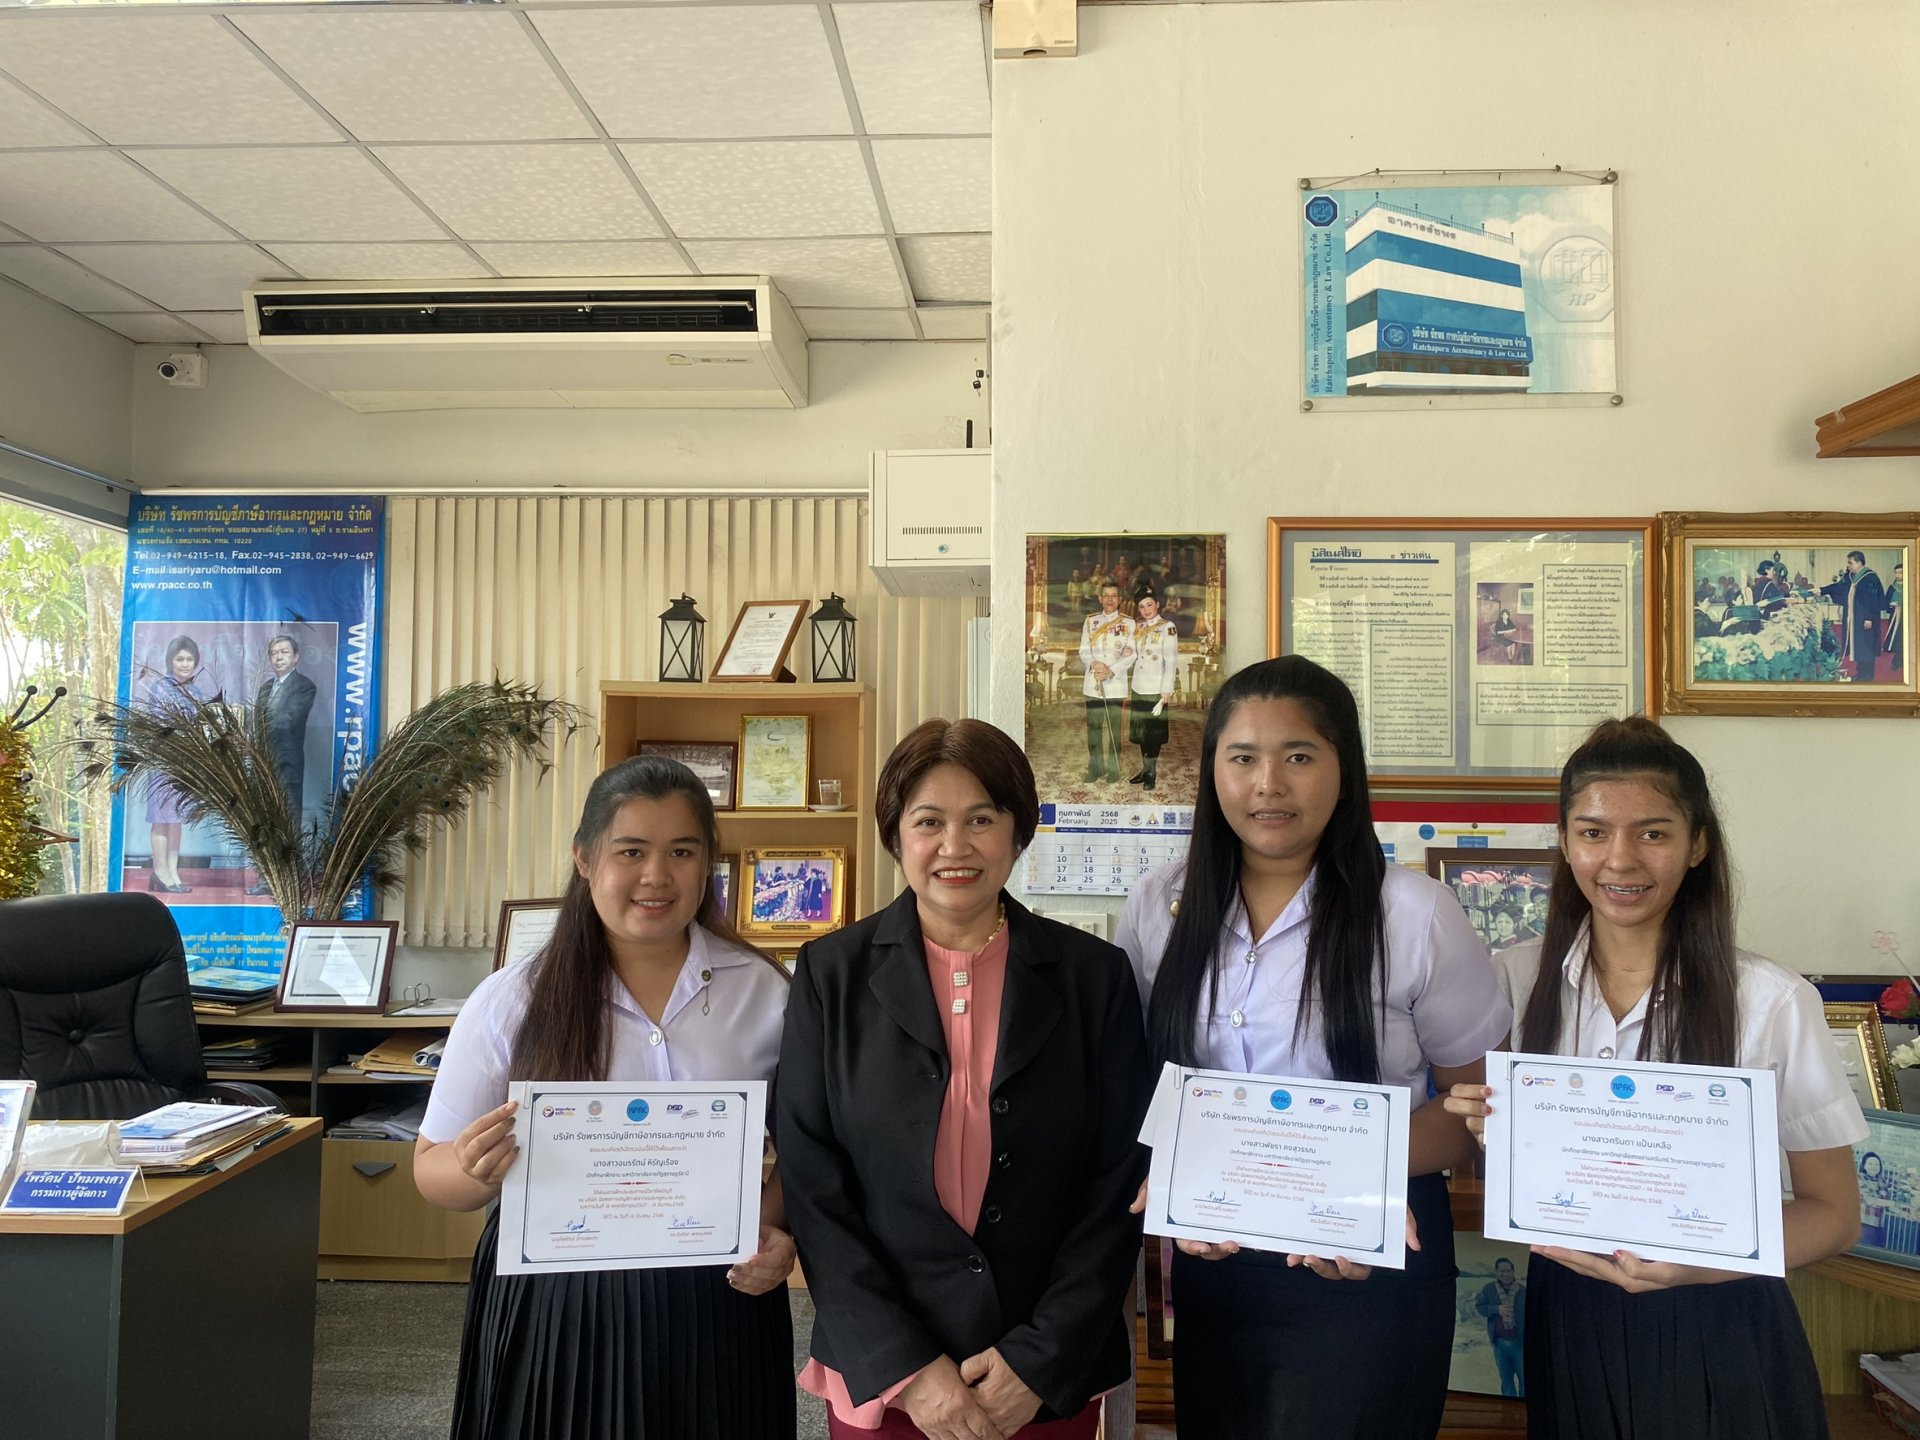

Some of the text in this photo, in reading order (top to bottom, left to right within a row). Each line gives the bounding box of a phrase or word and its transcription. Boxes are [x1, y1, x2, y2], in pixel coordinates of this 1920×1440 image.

[1324, 265, 1333, 282] Law
[1324, 295, 1334, 344] Accountancy
[1412, 342, 1450, 354] Ratchaporn
[1451, 346, 1487, 358] Accountancy
[1494, 349, 1506, 357] Law
[1324, 346, 1334, 393] Ratchaporn
[138, 504, 166, 521] บริษัท
[348, 504, 372, 521] จำกัด
[131, 580, 213, 591] www.rpacc.co.th
[1058, 809, 1119, 818] กุมภาพันธ์ 2568
[1058, 818, 1089, 826] February
[1612, 1083, 1675, 1092] RPAC DBD
[1309, 1097, 1325, 1105] DBD
[628, 1106, 648, 1114] RPAC
[1534, 1101, 1729, 1127] บริษัท รัชพรการบัญชีภาษีอากรและกฎหมาย จำกัด
[1200, 1110, 1369, 1135] บริษัท รัชพรการบัญชีภาษีอากรและกฎหมาย จำกัด
[553, 1129, 725, 1141] บริษัท รัชพรการบัญชีภาษีอากรและกฎหมาย จำกัด
[1582, 1134, 1672, 1150] นางสาวศรินดา แป้นเหลือ
[1241, 1140, 1316, 1154] นางสาวพัชรา คงสุวรรณ
[593, 1158, 679, 1168] นางสาวอมรรัตน์ หิรัญเรือง
[24, 1170, 125, 1185] ไพรัตน์ ปัทมพงศา
[30, 1185, 108, 1200] กรรมการผู้จัดการ
